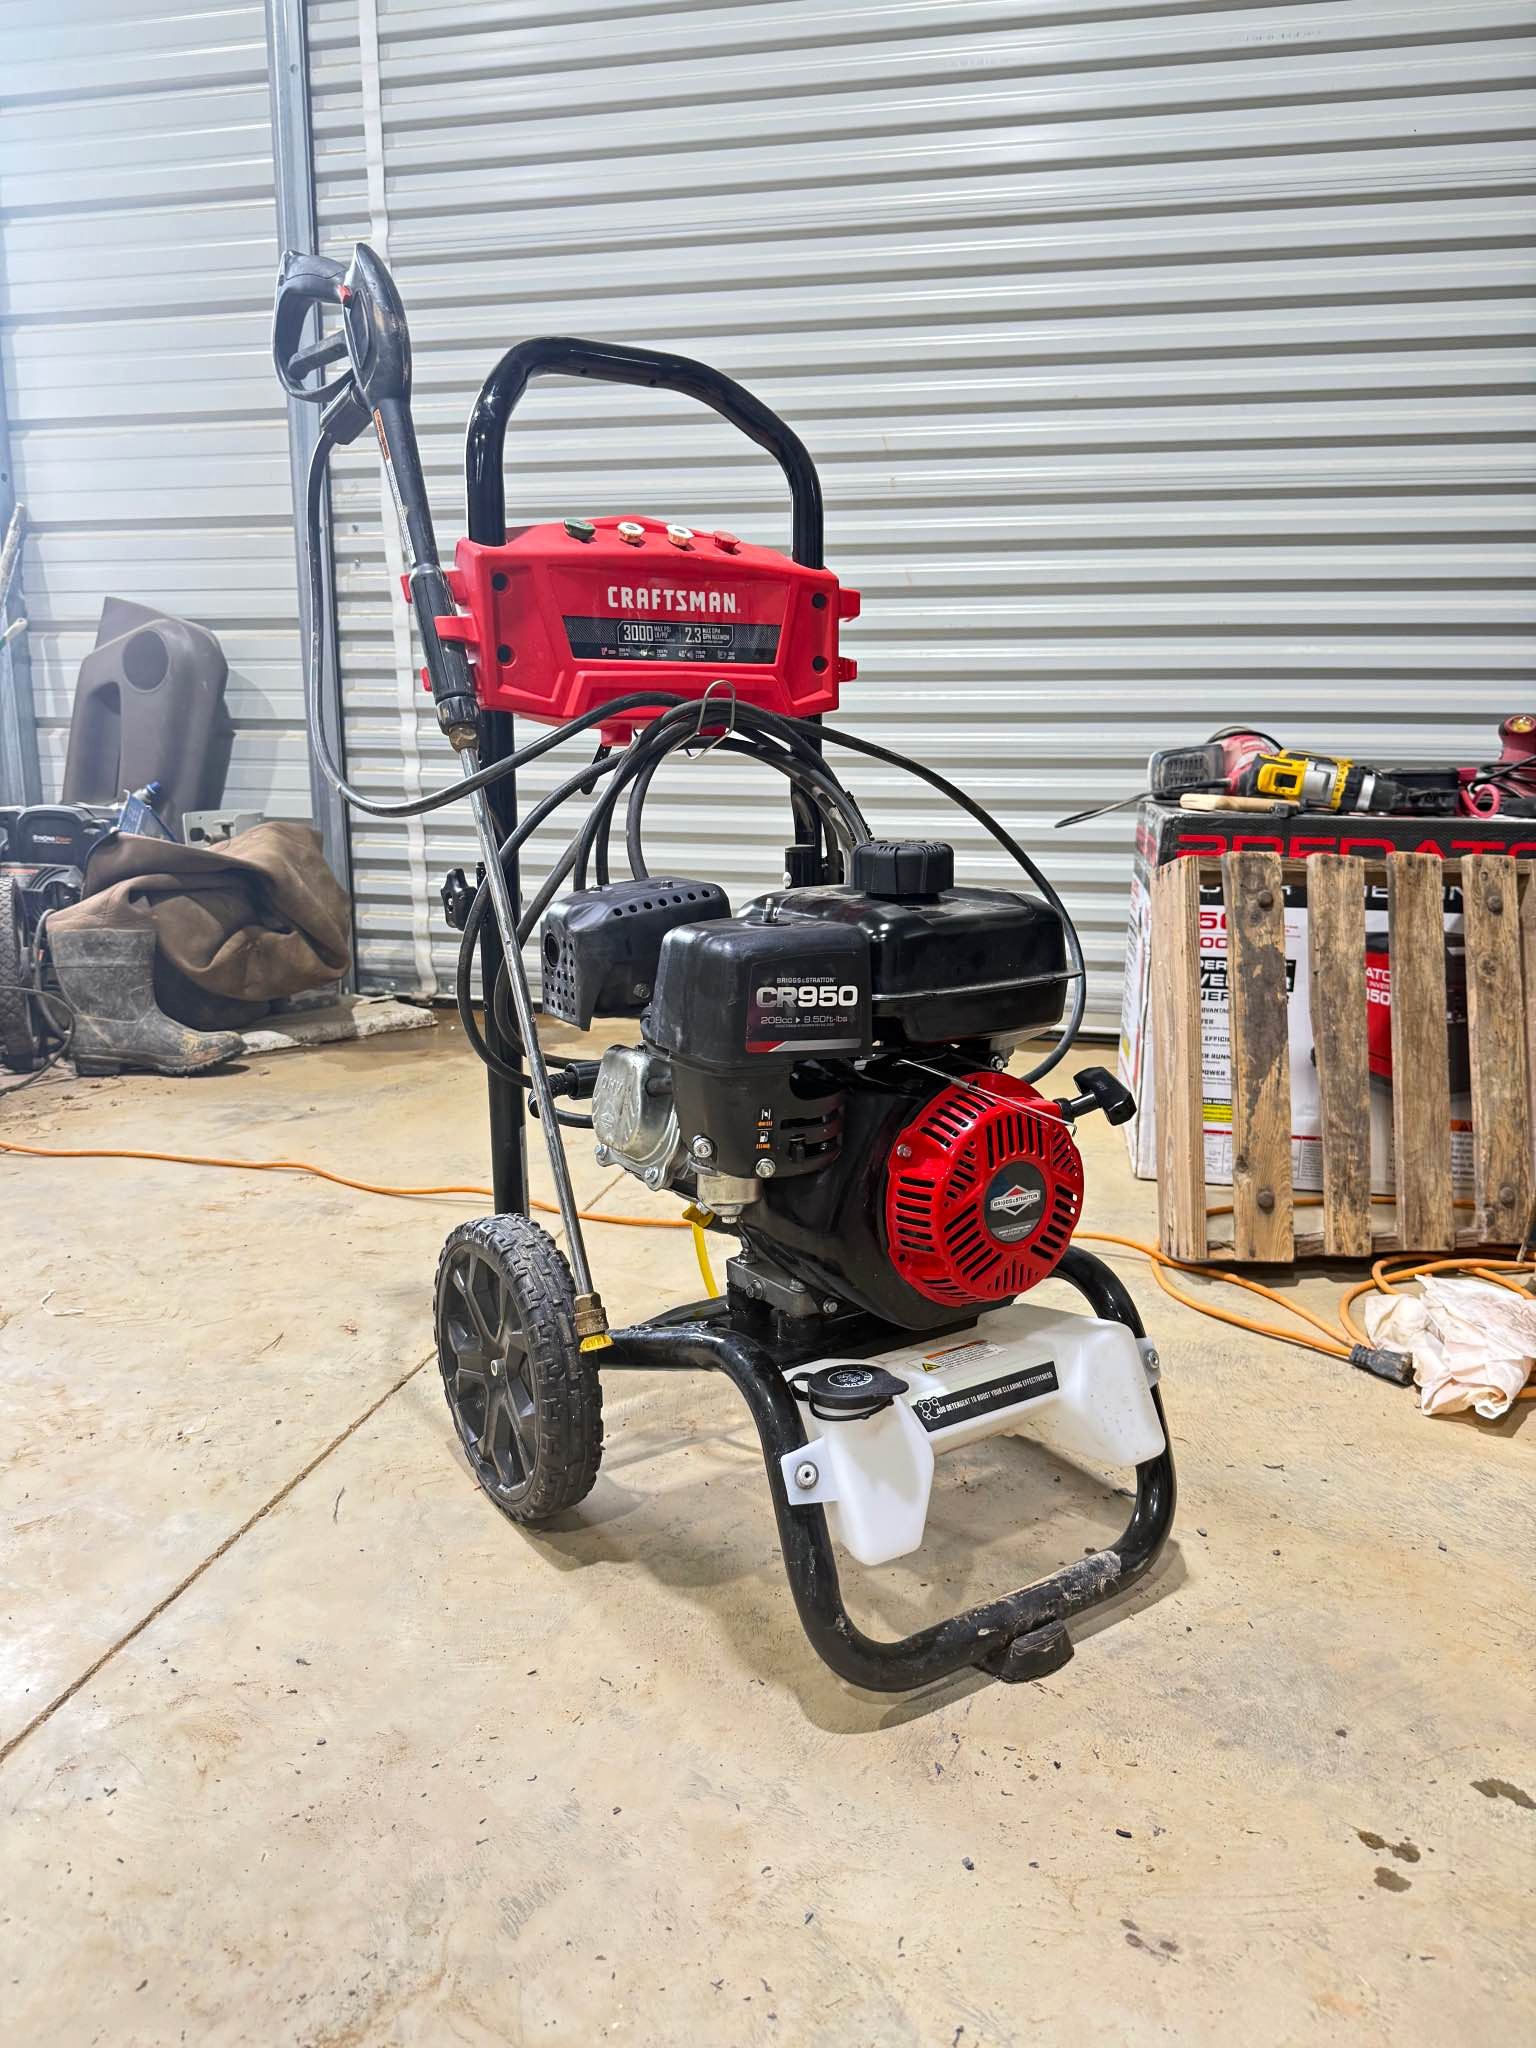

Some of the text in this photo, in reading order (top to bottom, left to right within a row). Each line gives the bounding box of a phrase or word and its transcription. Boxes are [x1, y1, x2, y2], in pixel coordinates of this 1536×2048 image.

[608, 586, 736, 613] CRAFTSMAN
[623, 625, 653, 641] 3000
[685, 627, 702, 643] 2.3
[756, 985, 858, 1007] CR950
